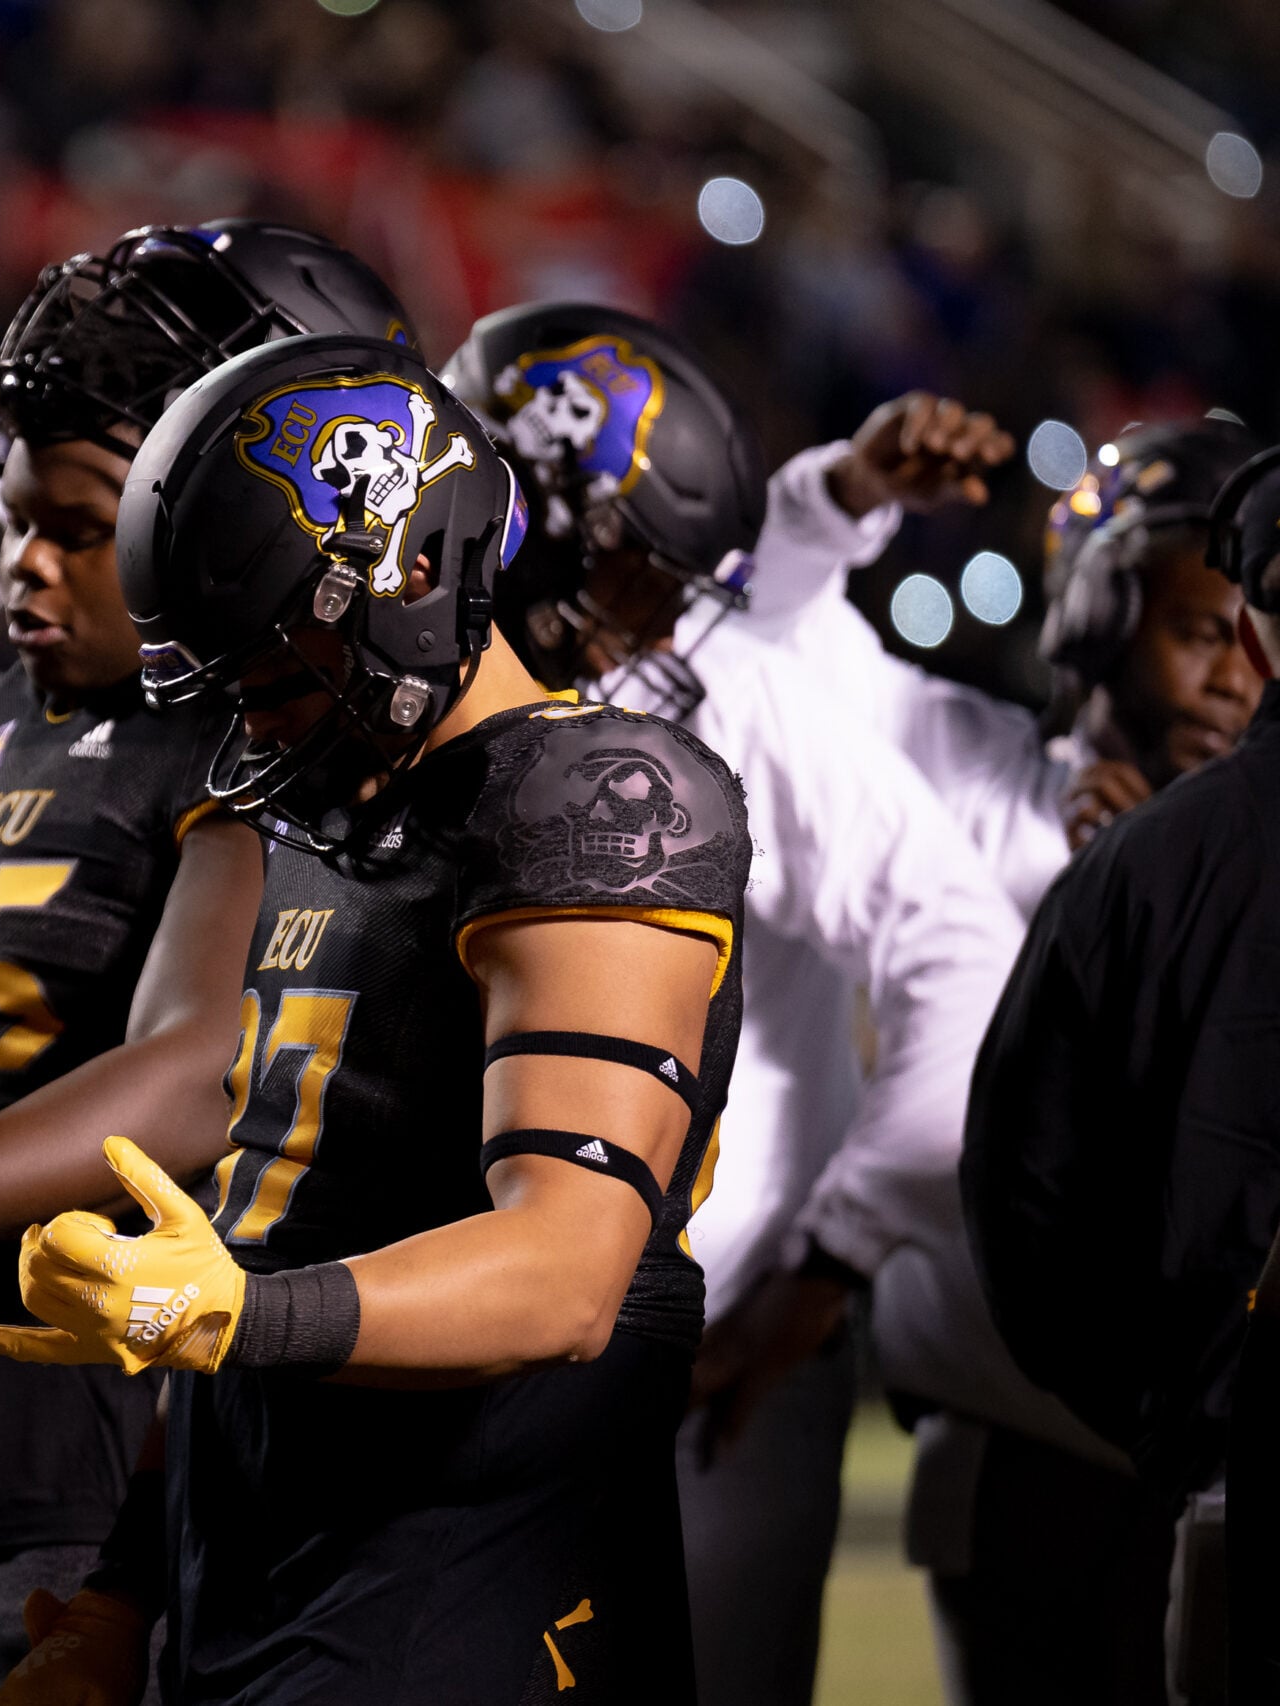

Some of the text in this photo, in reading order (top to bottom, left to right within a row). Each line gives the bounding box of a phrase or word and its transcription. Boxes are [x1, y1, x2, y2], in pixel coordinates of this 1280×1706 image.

[271, 401, 318, 468] ECU
[256, 908, 335, 972] ECU
[575, 1148, 609, 1164] adidas
